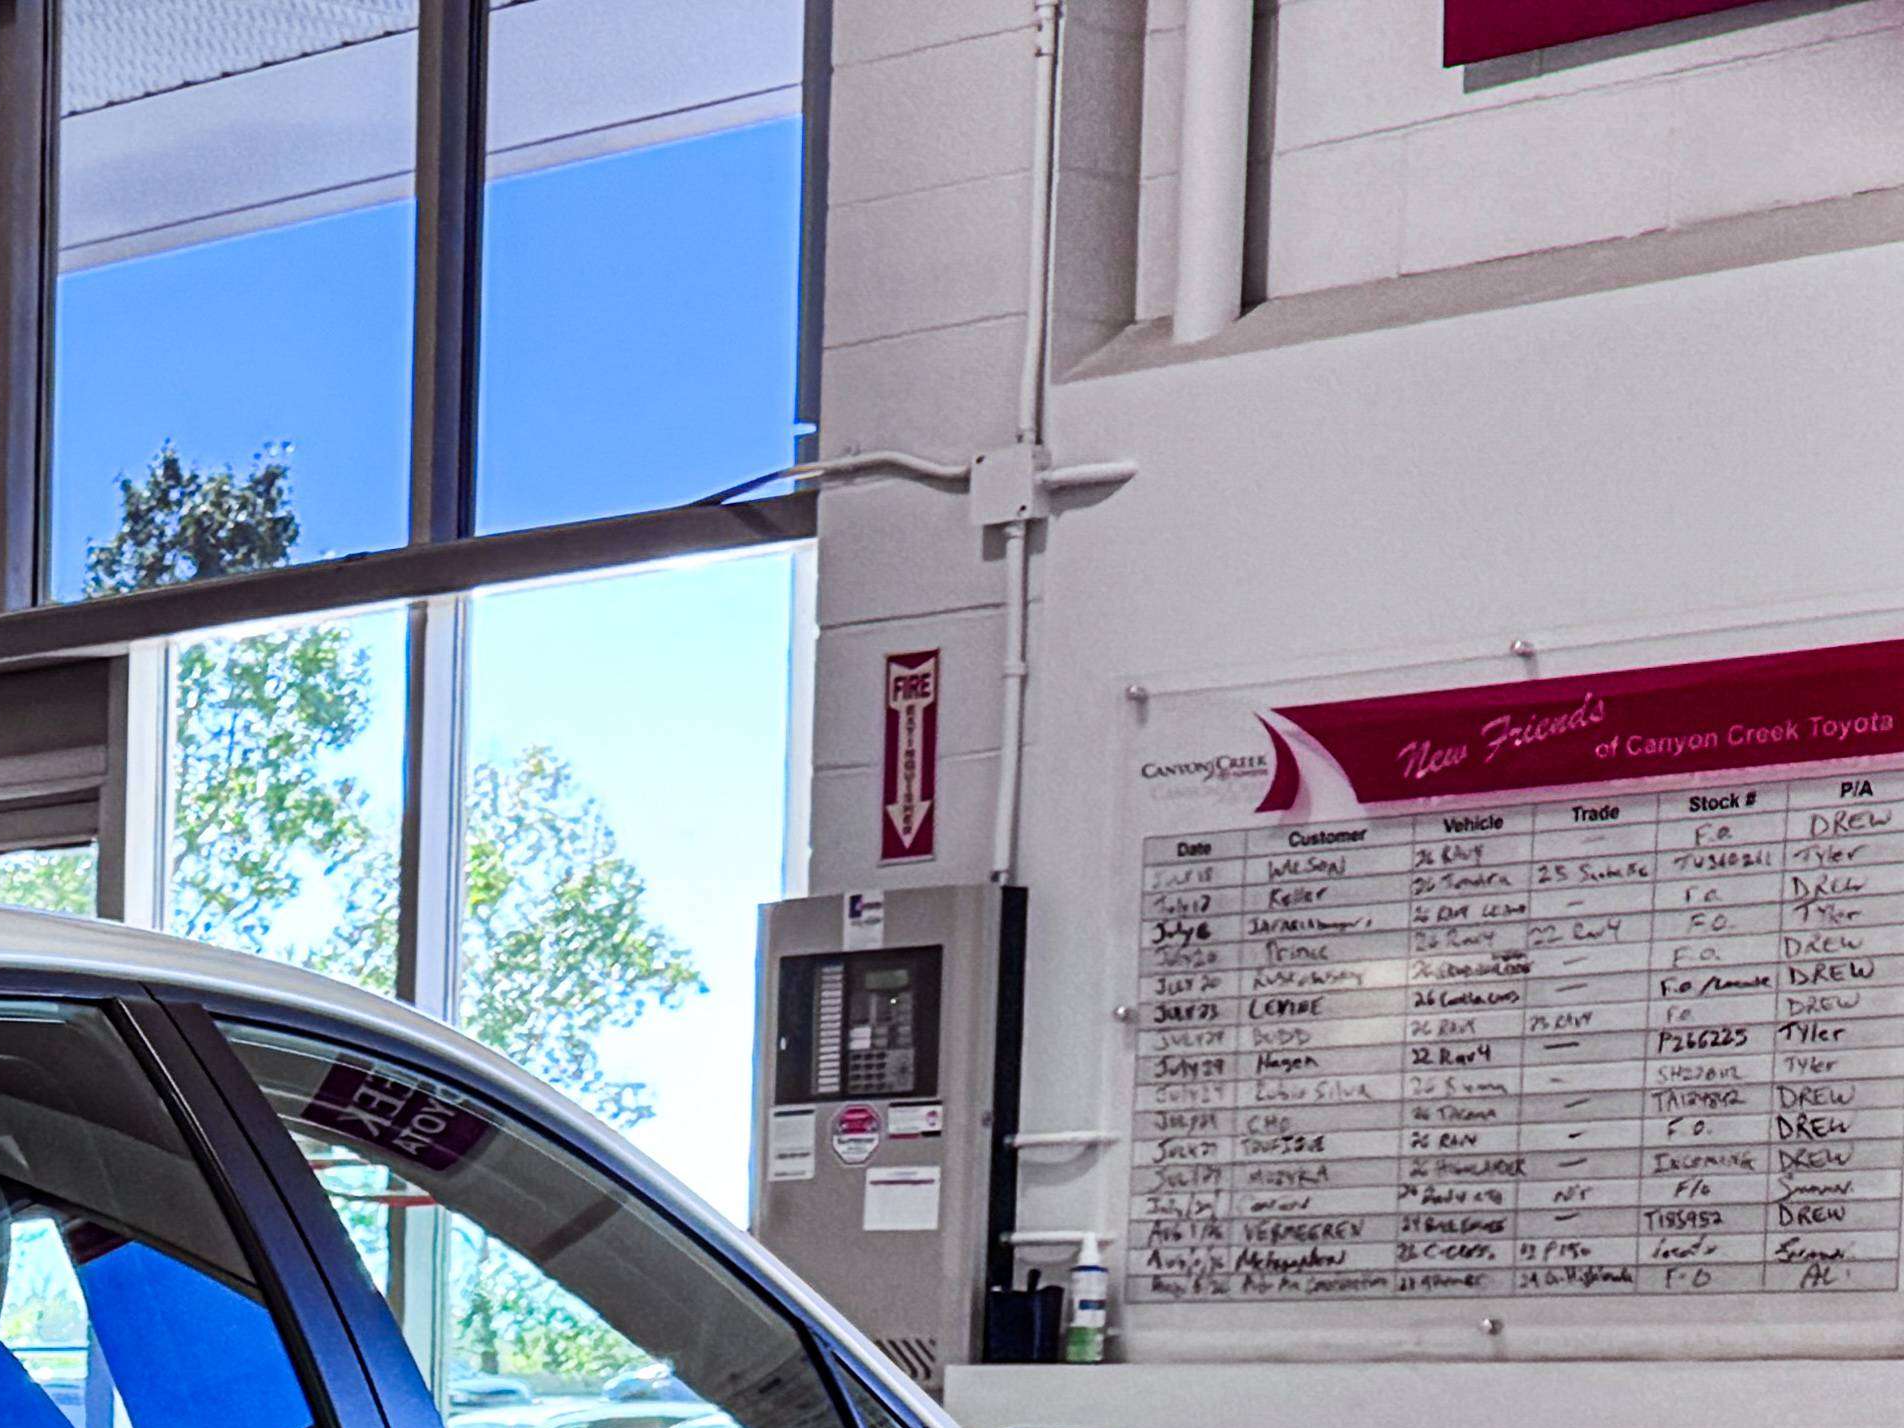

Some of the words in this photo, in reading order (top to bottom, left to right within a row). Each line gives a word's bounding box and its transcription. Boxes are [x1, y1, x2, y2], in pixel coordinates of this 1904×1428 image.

[893, 673, 931, 700] FIRE
[1397, 740, 1468, 778] New
[1481, 692, 1605, 763] Friends
[1595, 735, 1621, 758] of
[1626, 731, 1719, 757] Canyon
[1727, 721, 1799, 747] Creek
[1808, 712, 1894, 740] Toyota
[1841, 780, 1873, 798] P/A
[1571, 805, 1621, 822] Trade
[1689, 794, 1740, 813] Stock
[1443, 813, 1505, 834] Vehicle
[1810, 807, 1894, 838] DREW
[1176, 841, 1212, 857] Date
[1288, 829, 1368, 848] Customer
[1784, 935, 1864, 959] DREW
[1788, 960, 1875, 986] DREW
[1777, 1084, 1856, 1109] DREW
[1777, 1113, 1852, 1140] DREW
[1778, 1148, 1854, 1172] DREW
[1779, 1204, 1847, 1227] DREW
